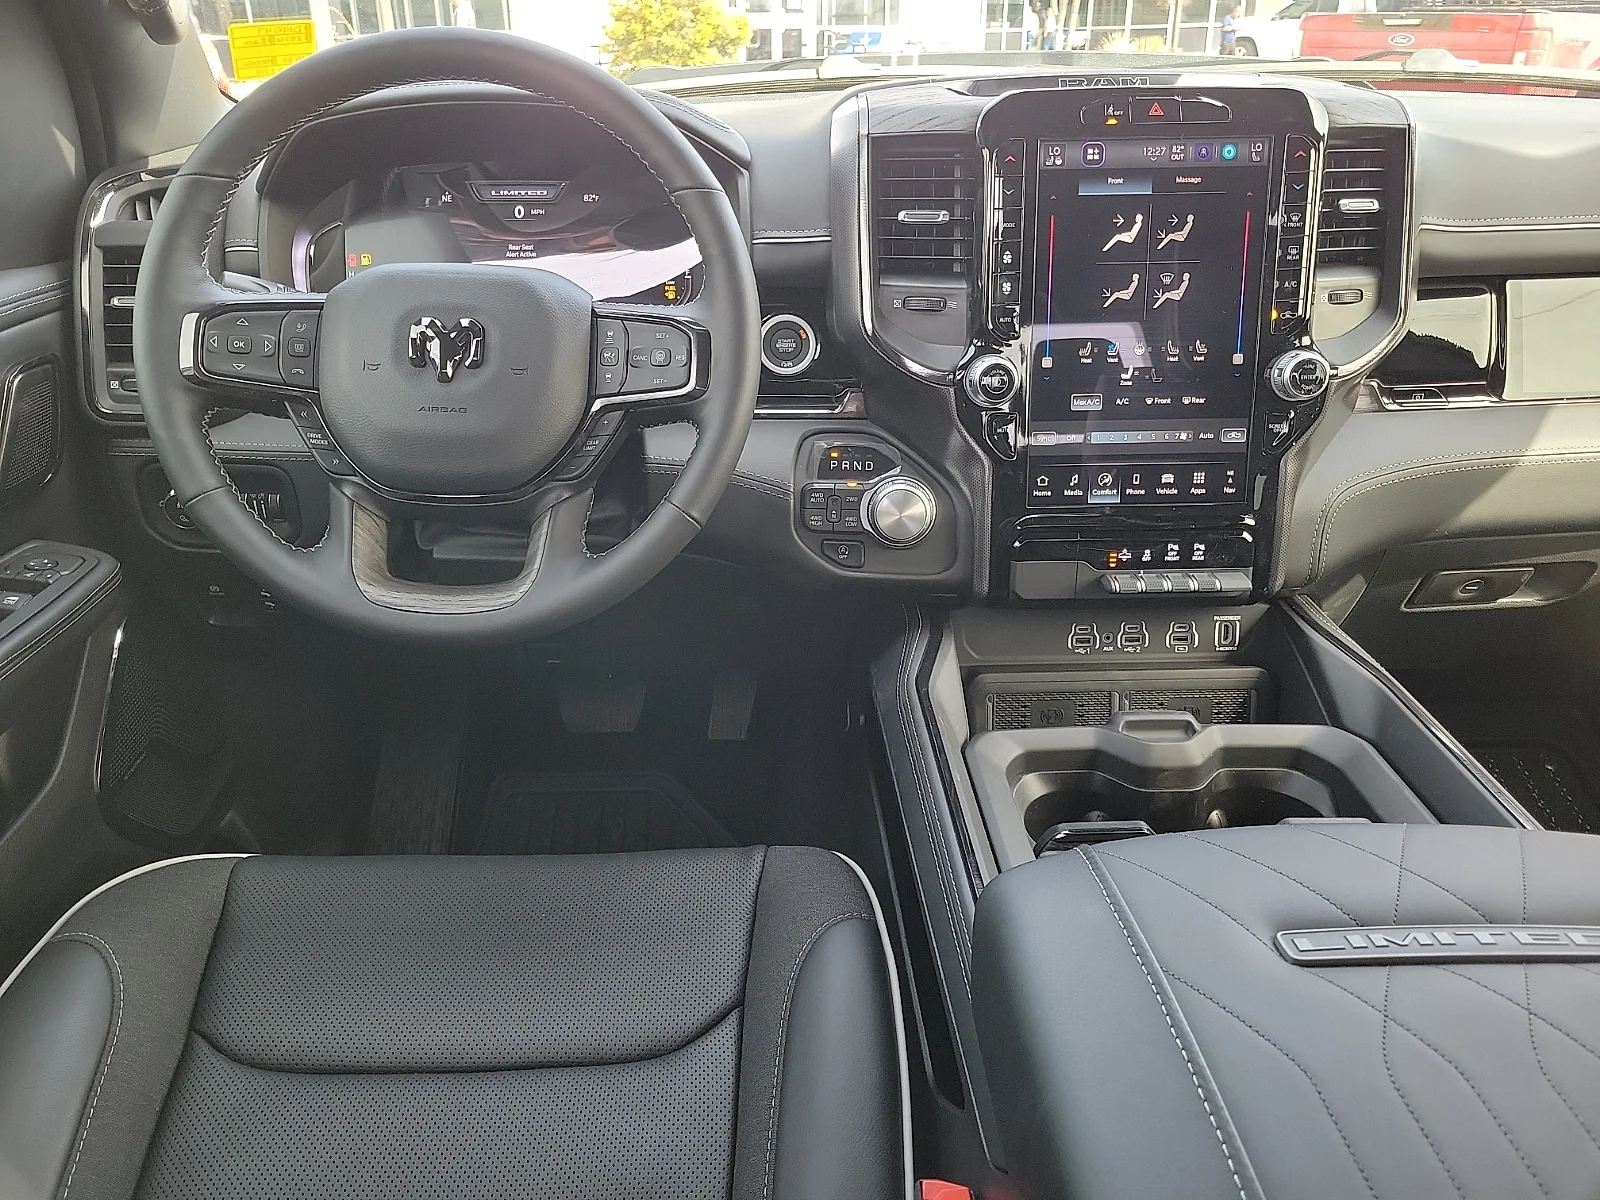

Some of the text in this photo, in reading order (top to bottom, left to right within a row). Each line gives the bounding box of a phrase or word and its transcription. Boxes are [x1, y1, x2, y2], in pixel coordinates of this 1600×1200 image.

[1058, 77, 1150, 89] RAM
[1049, 146, 1061, 155] LO
[1143, 147, 1167, 156] 12:27
[1251, 143, 1262, 152] LO
[1108, 177, 1124, 185] Front
[1175, 176, 1202, 184] Massage
[442, 194, 453, 203] NE
[514, 205, 525, 219] 0
[531, 208, 545, 216] MPH
[508, 243, 534, 251] Rear Seat
[233, 341, 245, 349] OK
[1115, 398, 1129, 406] A/C
[1154, 397, 1172, 405] Front
[1191, 397, 1206, 405] Rear
[418, 406, 468, 414] AIRBAG
[310, 438, 329, 446] MODES
[1036, 435, 1051, 443] Sync
[1033, 489, 1051, 497] Home
[1092, 488, 1117, 496] Comfort
[1156, 487, 1178, 495] Vehicle
[1190, 487, 1206, 496] Apps
[1224, 486, 1236, 494] Nav
